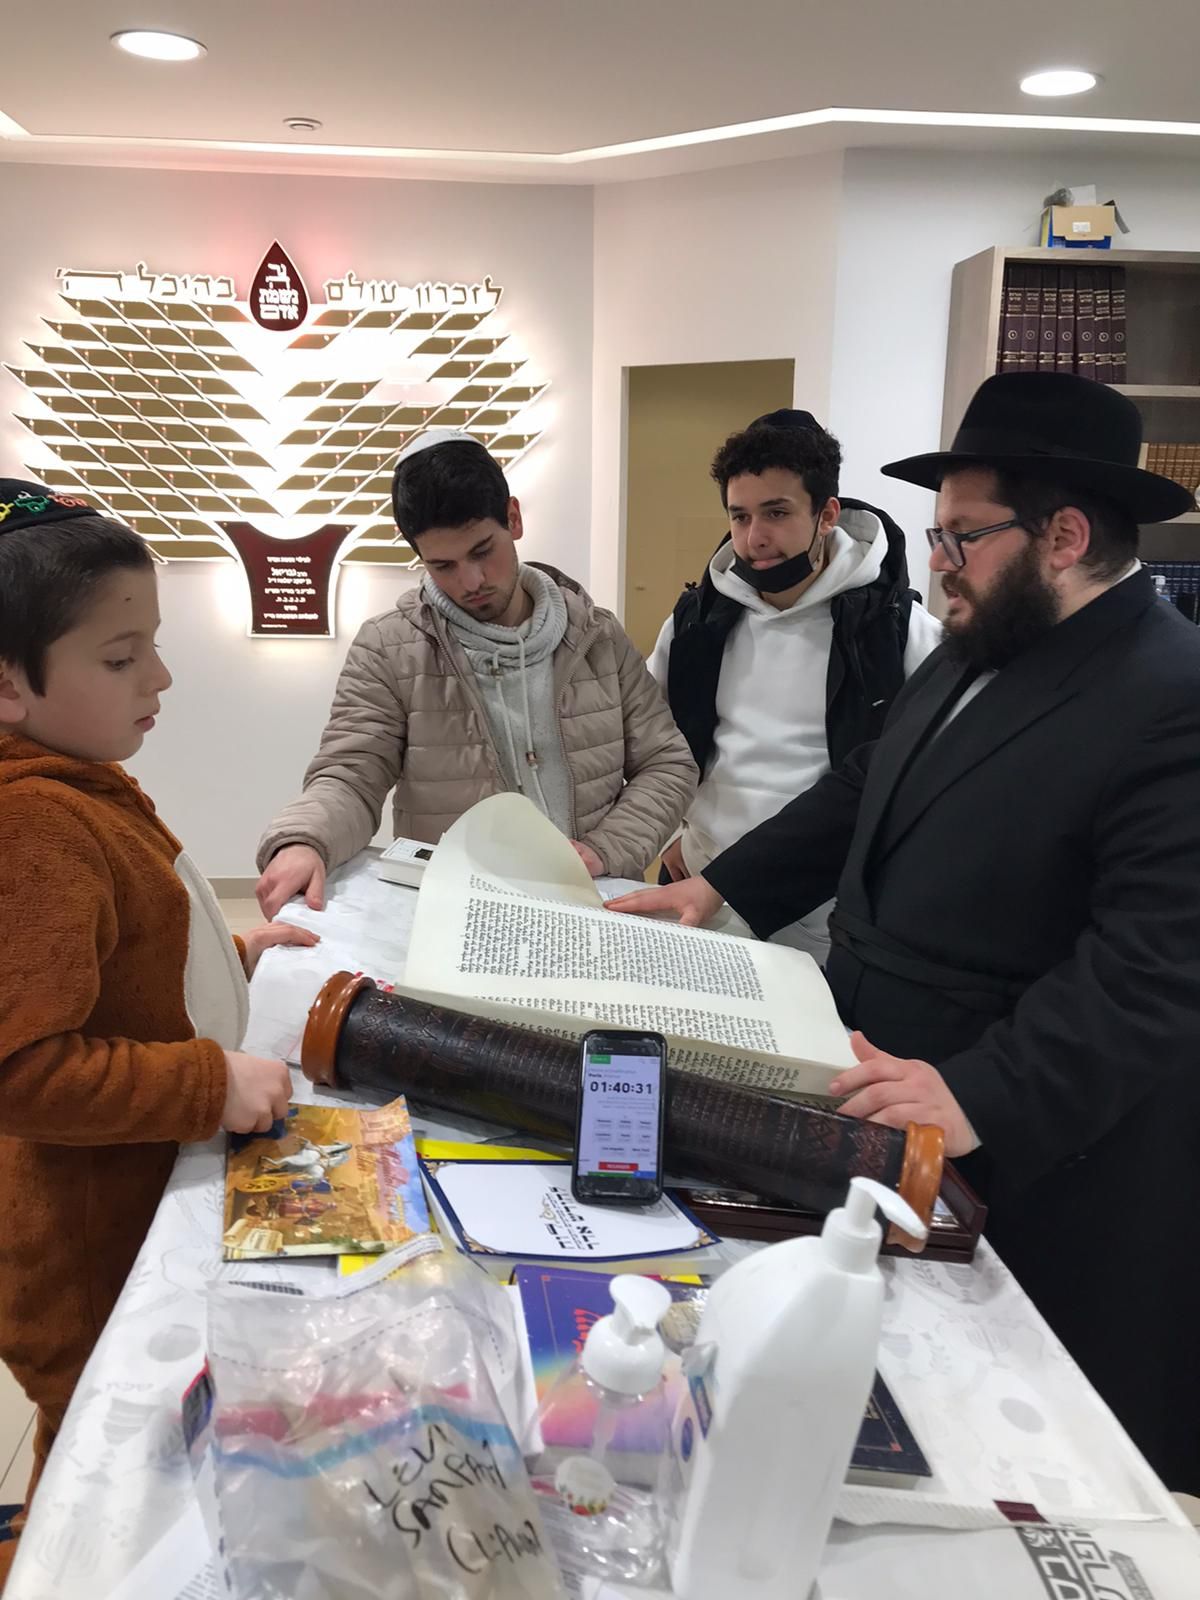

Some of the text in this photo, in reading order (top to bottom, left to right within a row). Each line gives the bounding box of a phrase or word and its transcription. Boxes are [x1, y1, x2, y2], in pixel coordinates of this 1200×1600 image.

[136, 263, 234, 298] בהיכל
[326, 272, 503, 308] לזכרון עולם
[260, 304, 299, 320] אדם
[590, 1081, 652, 1095] 01:40:31
